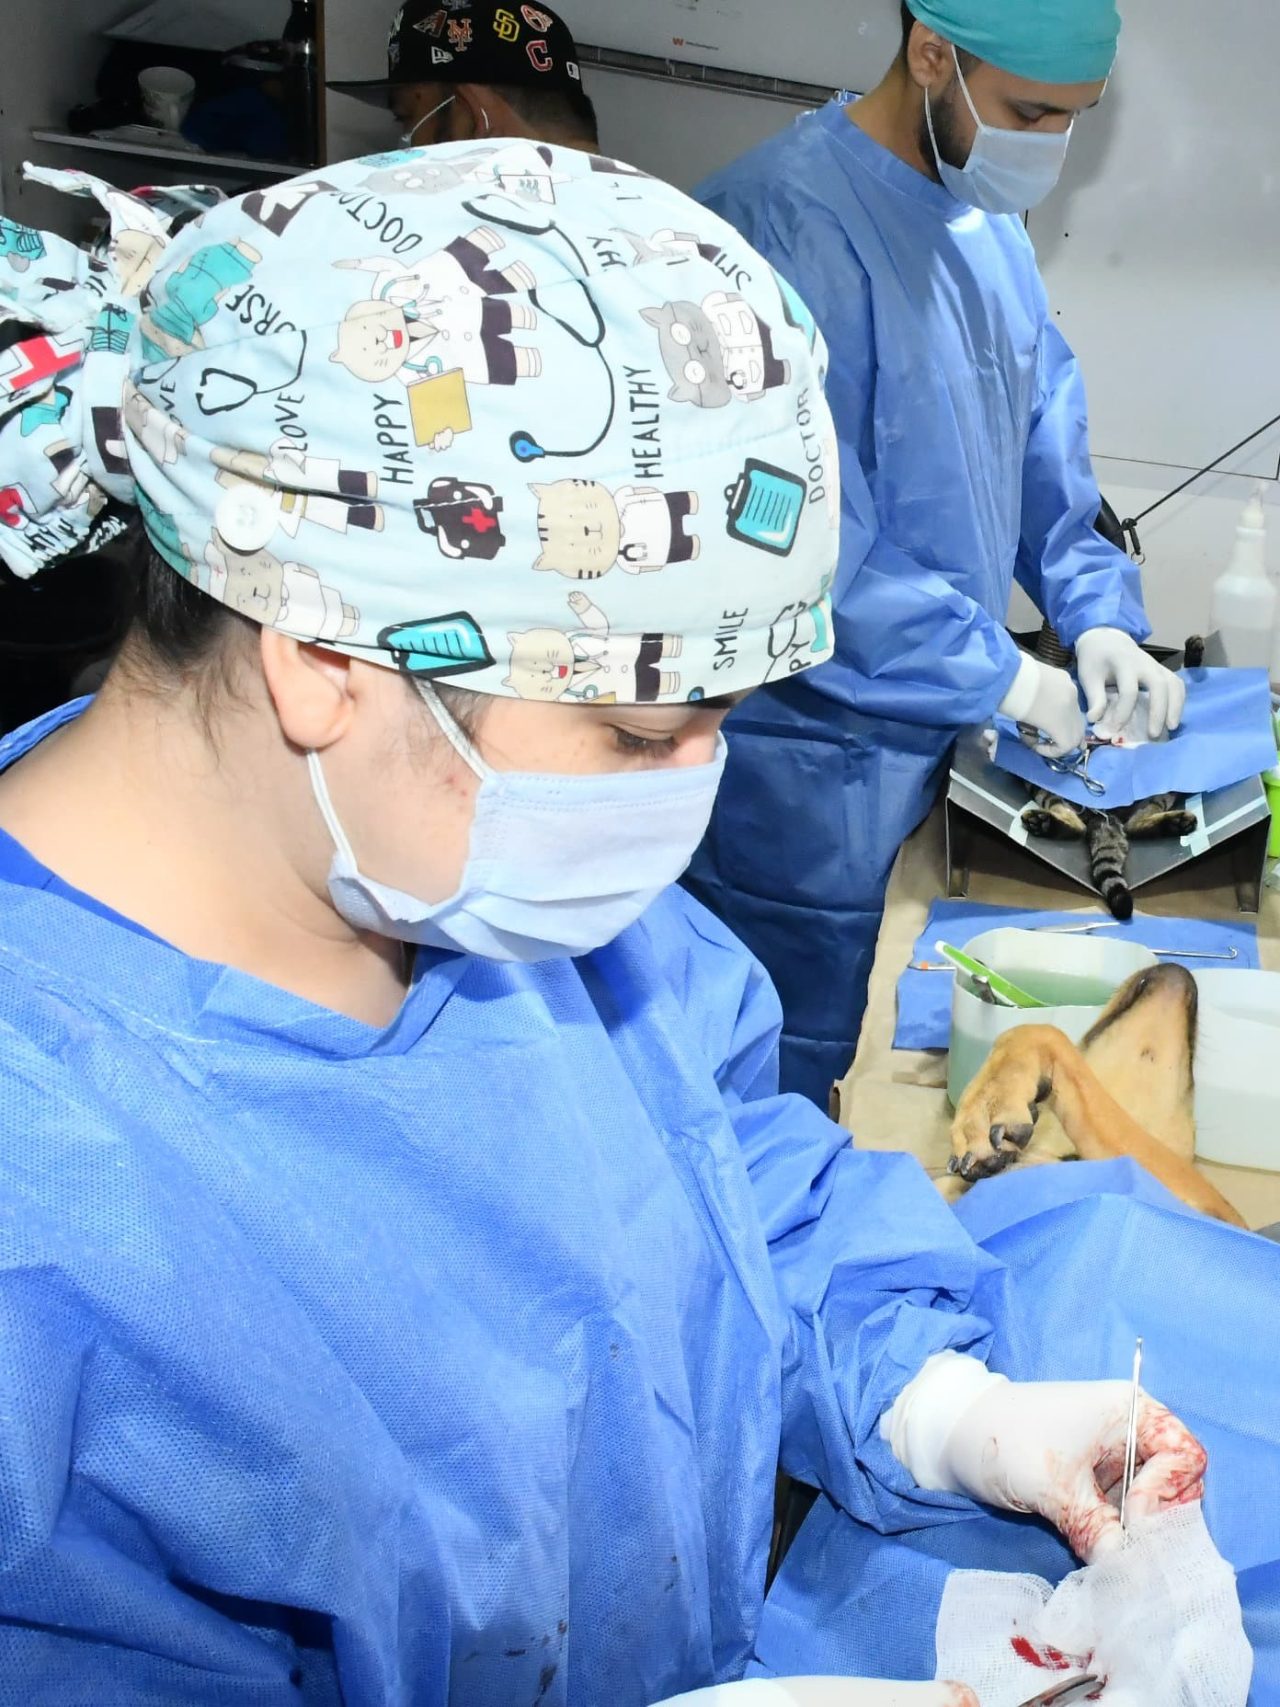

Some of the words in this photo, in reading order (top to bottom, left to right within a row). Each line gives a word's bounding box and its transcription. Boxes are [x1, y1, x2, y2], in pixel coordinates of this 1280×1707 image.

[525, 40, 553, 72] C
[275, 390, 309, 454] LOVE
[373, 393, 415, 485] HAPPY
[623, 365, 664, 479] HEALTHY
[796, 387, 826, 504] DOCTOR
[713, 607, 749, 672] SMILE
